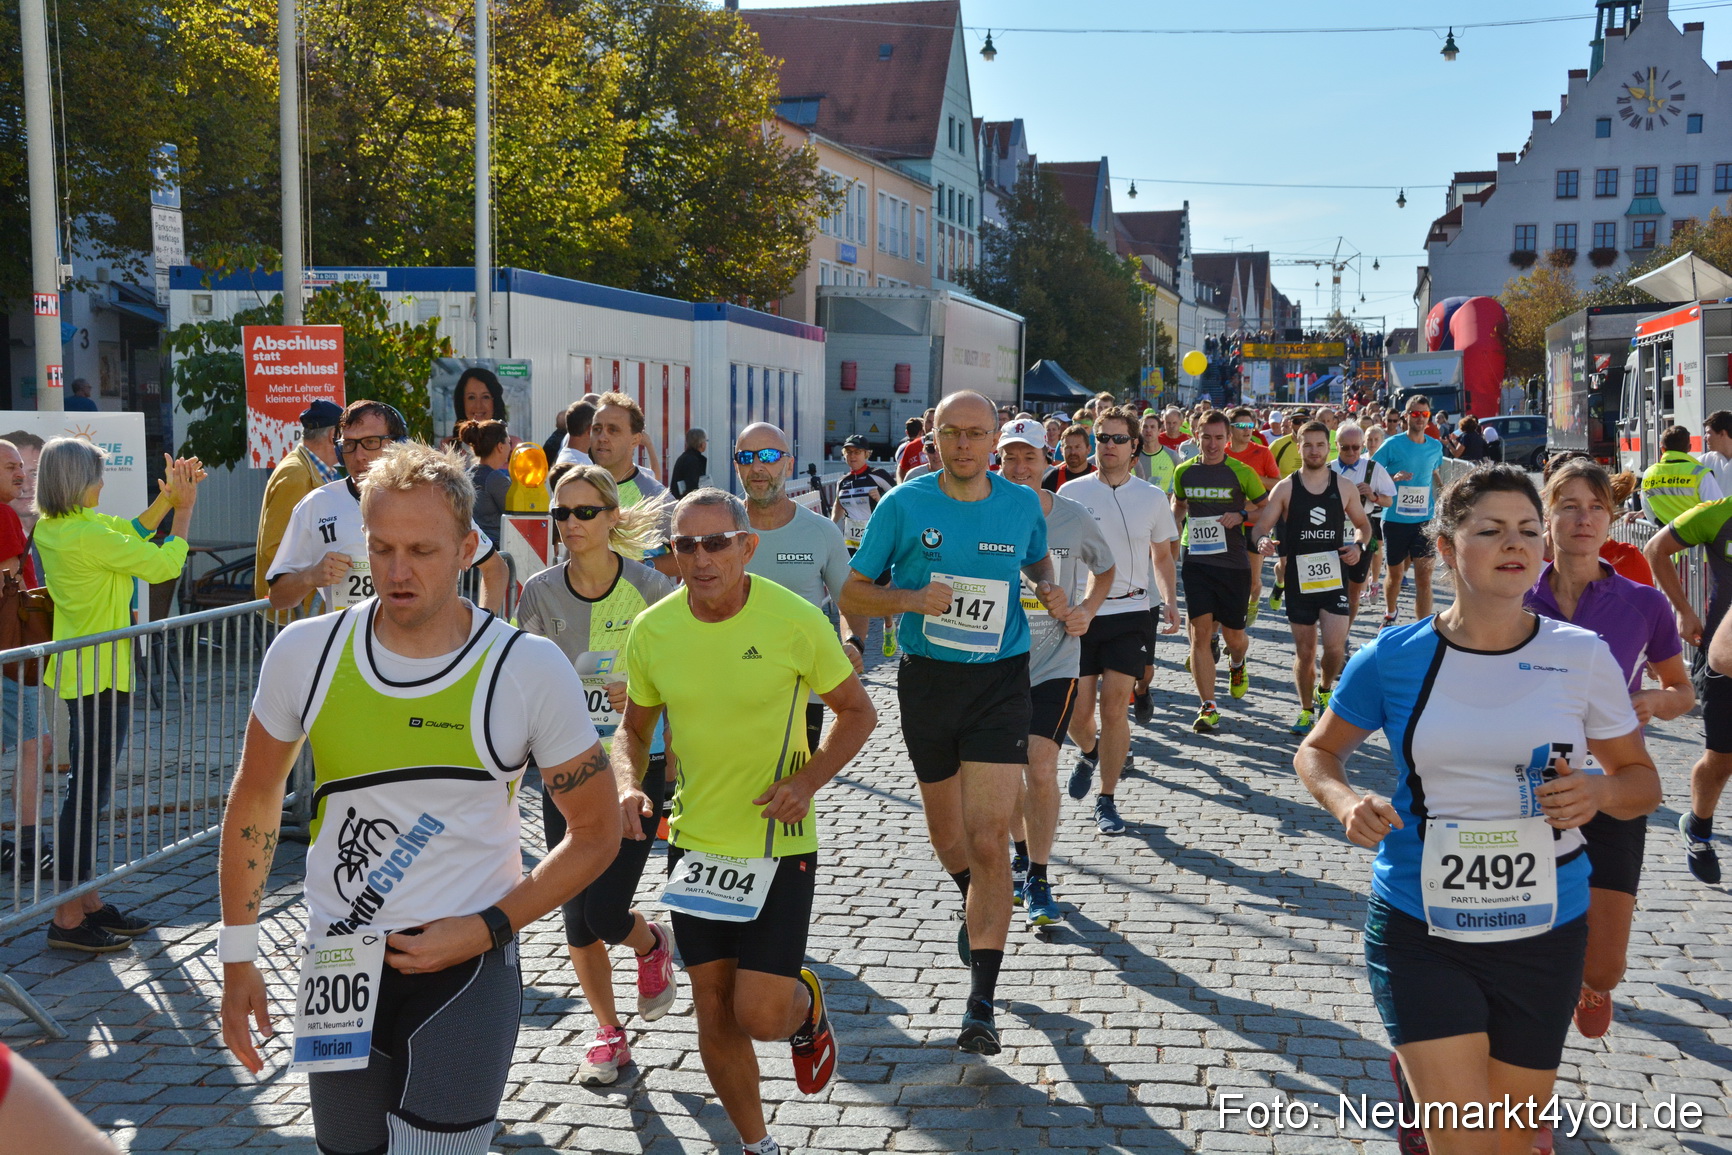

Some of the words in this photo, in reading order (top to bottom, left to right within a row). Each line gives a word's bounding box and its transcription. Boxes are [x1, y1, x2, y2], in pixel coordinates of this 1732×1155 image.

[155, 222, 181, 233] Parkschein
[80, 328, 90, 349] 3
[252, 335, 337, 350] Abschluss
[252, 352, 281, 361] statt
[1275, 346, 1311, 354] START
[254, 362, 338, 375] Ausschluss!
[269, 384, 292, 393] Mehr
[294, 384, 322, 393] Lehrer
[324, 383, 336, 392] für
[265, 394, 301, 403] kleinere
[1184, 487, 1233, 499] BOCK
[1402, 494, 1425, 504] 2348
[319, 522, 337, 544] 11
[1192, 526, 1219, 539] 3102
[1300, 529, 1336, 540] SINGER
[978, 541, 1016, 553] BOCK
[776, 552, 814, 562] BOCK
[1307, 562, 1331, 577] 336
[952, 581, 987, 593] BOCK
[941, 617, 957, 626] PARTL
[958, 621, 982, 630] Neumarkt
[1519, 785, 1528, 816] WATER
[1459, 831, 1519, 845] BOCK
[1440, 852, 1537, 890] 2492
[683, 862, 756, 895] 3104
[706, 890, 735, 901] Neumarkt
[1451, 896, 1479, 904] PARTL
[1481, 894, 1520, 904] Neumarkt
[1456, 911, 1526, 928] Christina
[315, 947, 355, 965] BOCK
[304, 972, 370, 1016] 2306
[307, 1022, 322, 1030] PARTL
[323, 1020, 355, 1029] Neumarkt
[313, 1038, 352, 1057] Florian
